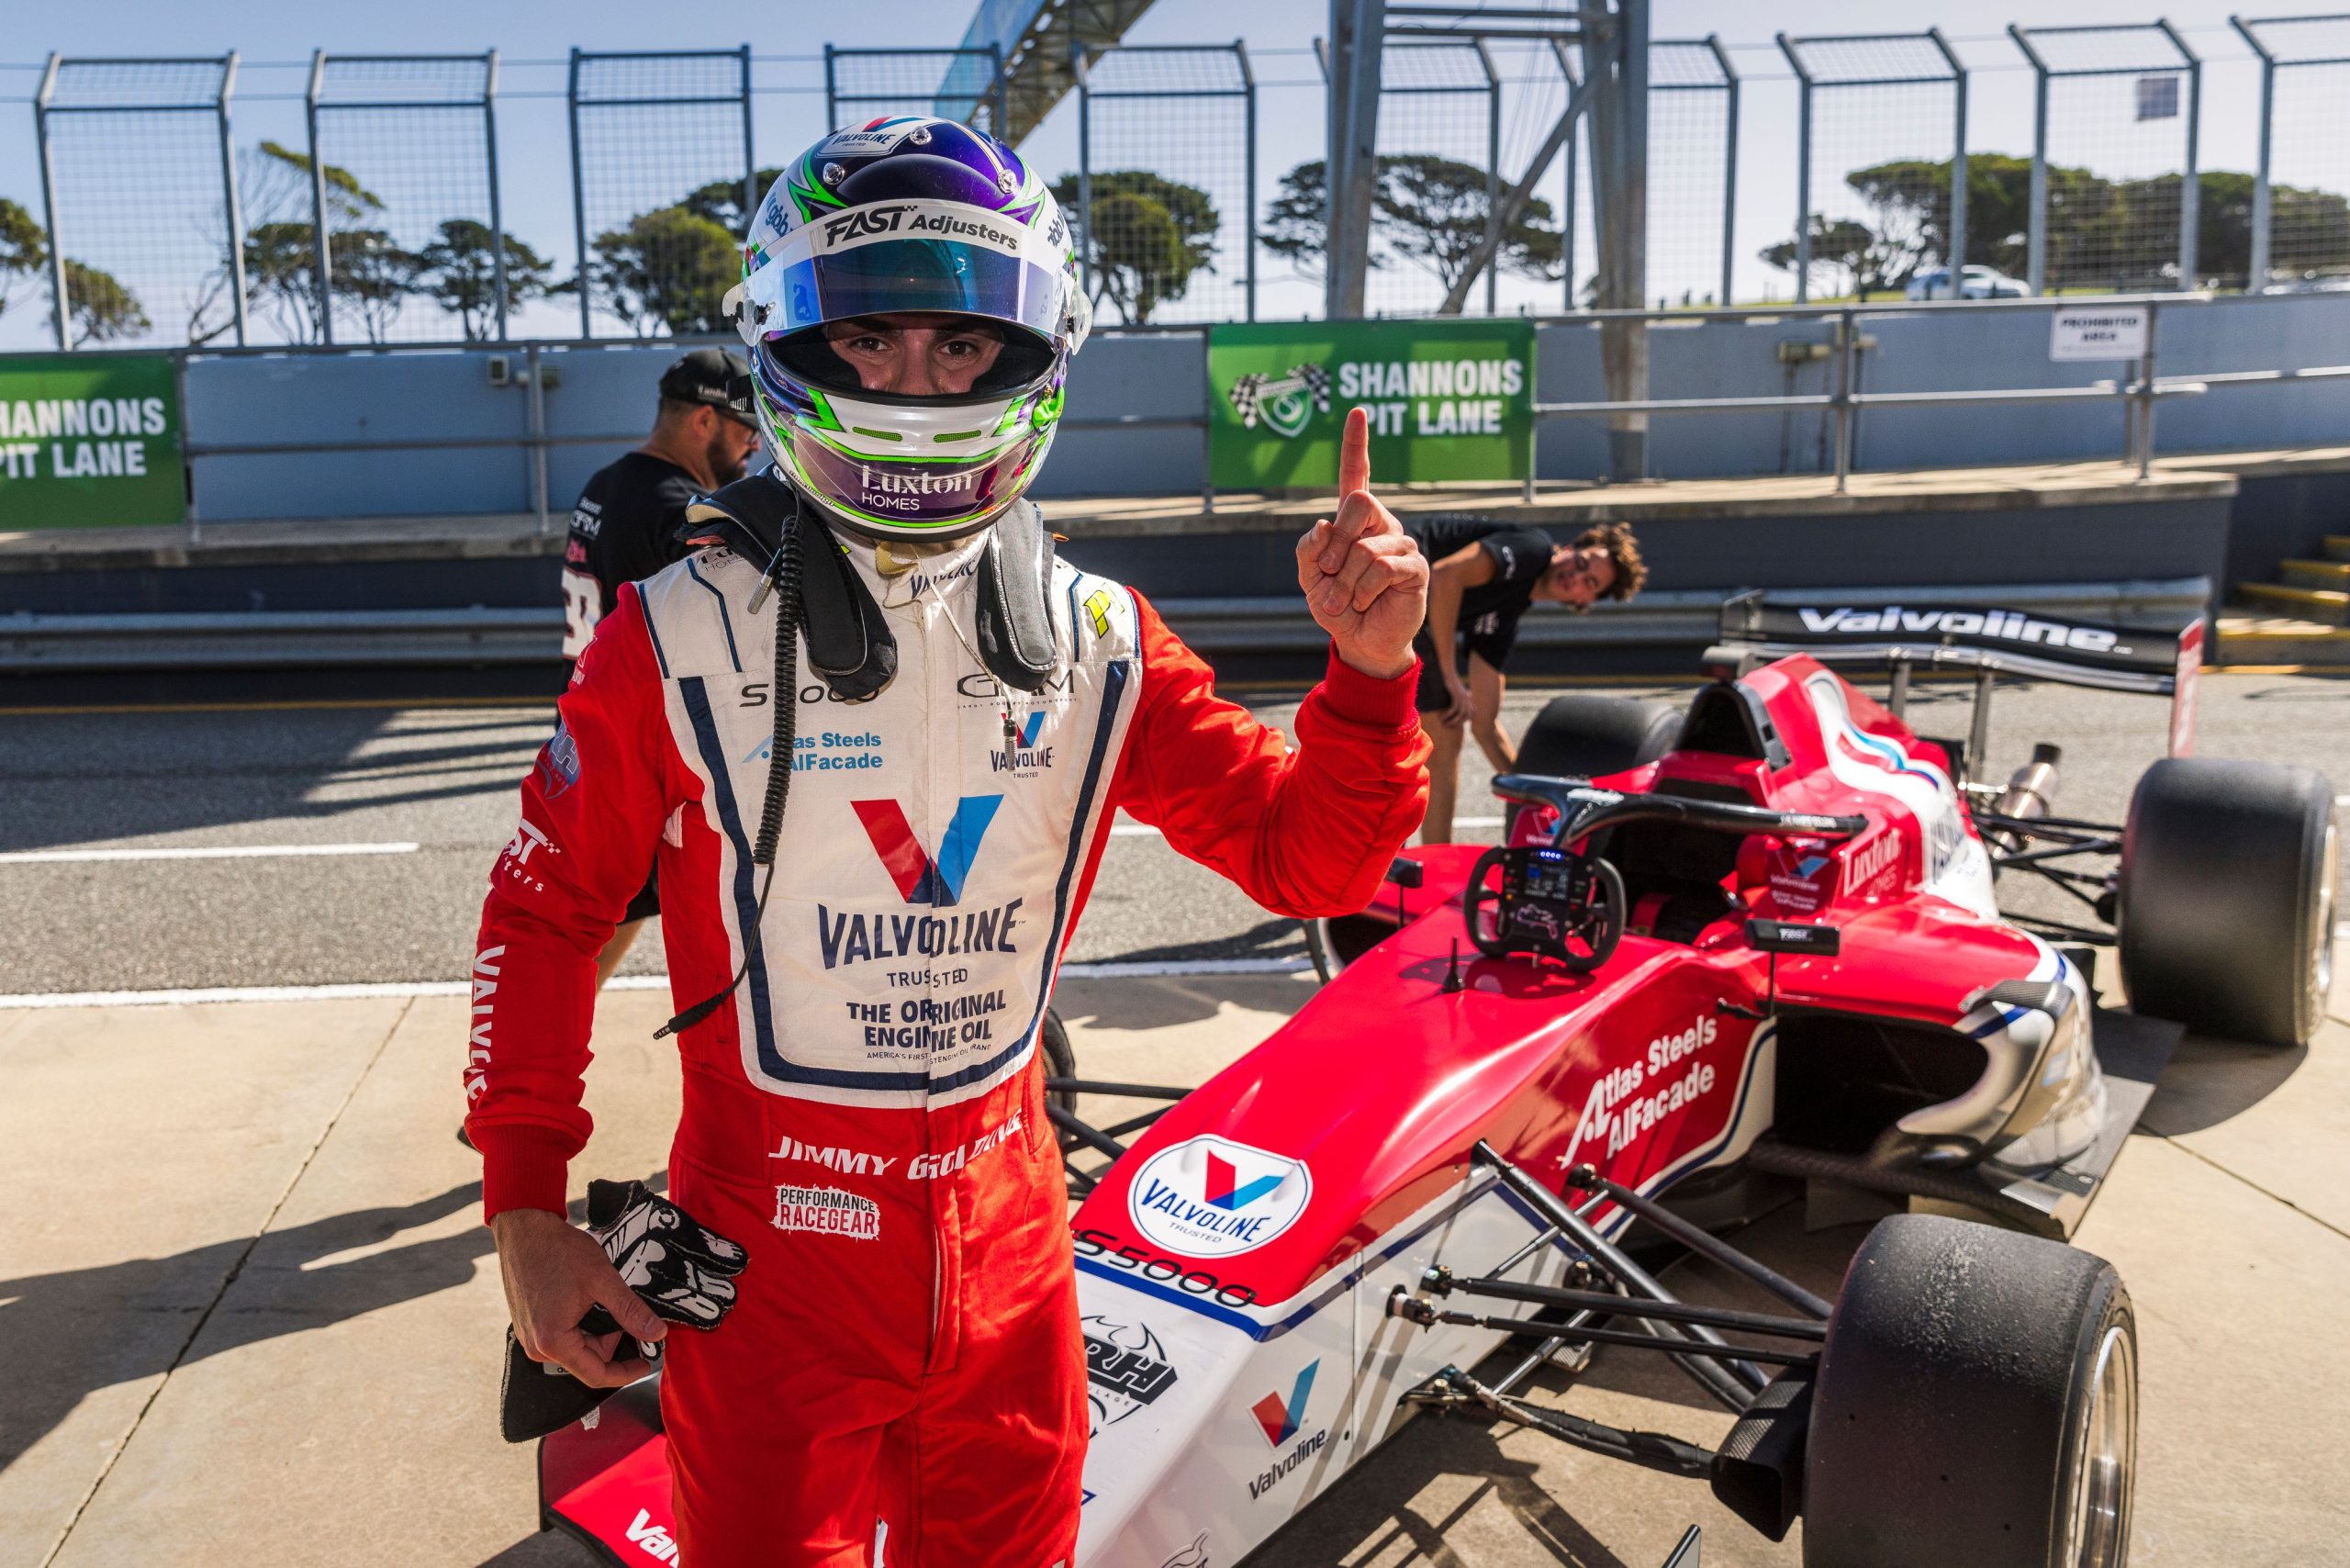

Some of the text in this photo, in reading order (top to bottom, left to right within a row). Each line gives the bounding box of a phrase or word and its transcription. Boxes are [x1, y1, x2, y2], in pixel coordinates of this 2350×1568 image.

[832, 133, 897, 145] VALVOLINE
[824, 206, 917, 248] FAST
[909, 214, 1018, 251] Adjusters
[1338, 359, 1523, 398] SHANNONS
[1417, 399, 1503, 436] LANE
[51, 441, 147, 478] LANE
[861, 465, 972, 496] Luxton
[861, 492, 920, 511] HOMES
[1798, 606, 2117, 653] Valvoline
[822, 732, 881, 748] Steels
[990, 746, 1053, 773] VAVOLINE
[817, 897, 1024, 970] VALVOLINE
[886, 968, 968, 989] TRUSTED
[846, 989, 1007, 1026] THE ORIGINAL
[864, 1019, 992, 1053] ENGINE OIL
[1561, 1014, 1718, 1170] Atlas Steels
[1606, 1060, 1716, 1160] AlFacade
[767, 1136, 899, 1176] JIMMY
[780, 1188, 876, 1213] PERFORMANCE
[1141, 1178, 1272, 1243] VALVOLINE
[779, 1204, 876, 1235] RACEGEAR
[1169, 1221, 1223, 1243] TRUSTED
[1074, 1228, 1259, 1309] S5000
[1248, 1428, 1326, 1501] Valvoline
